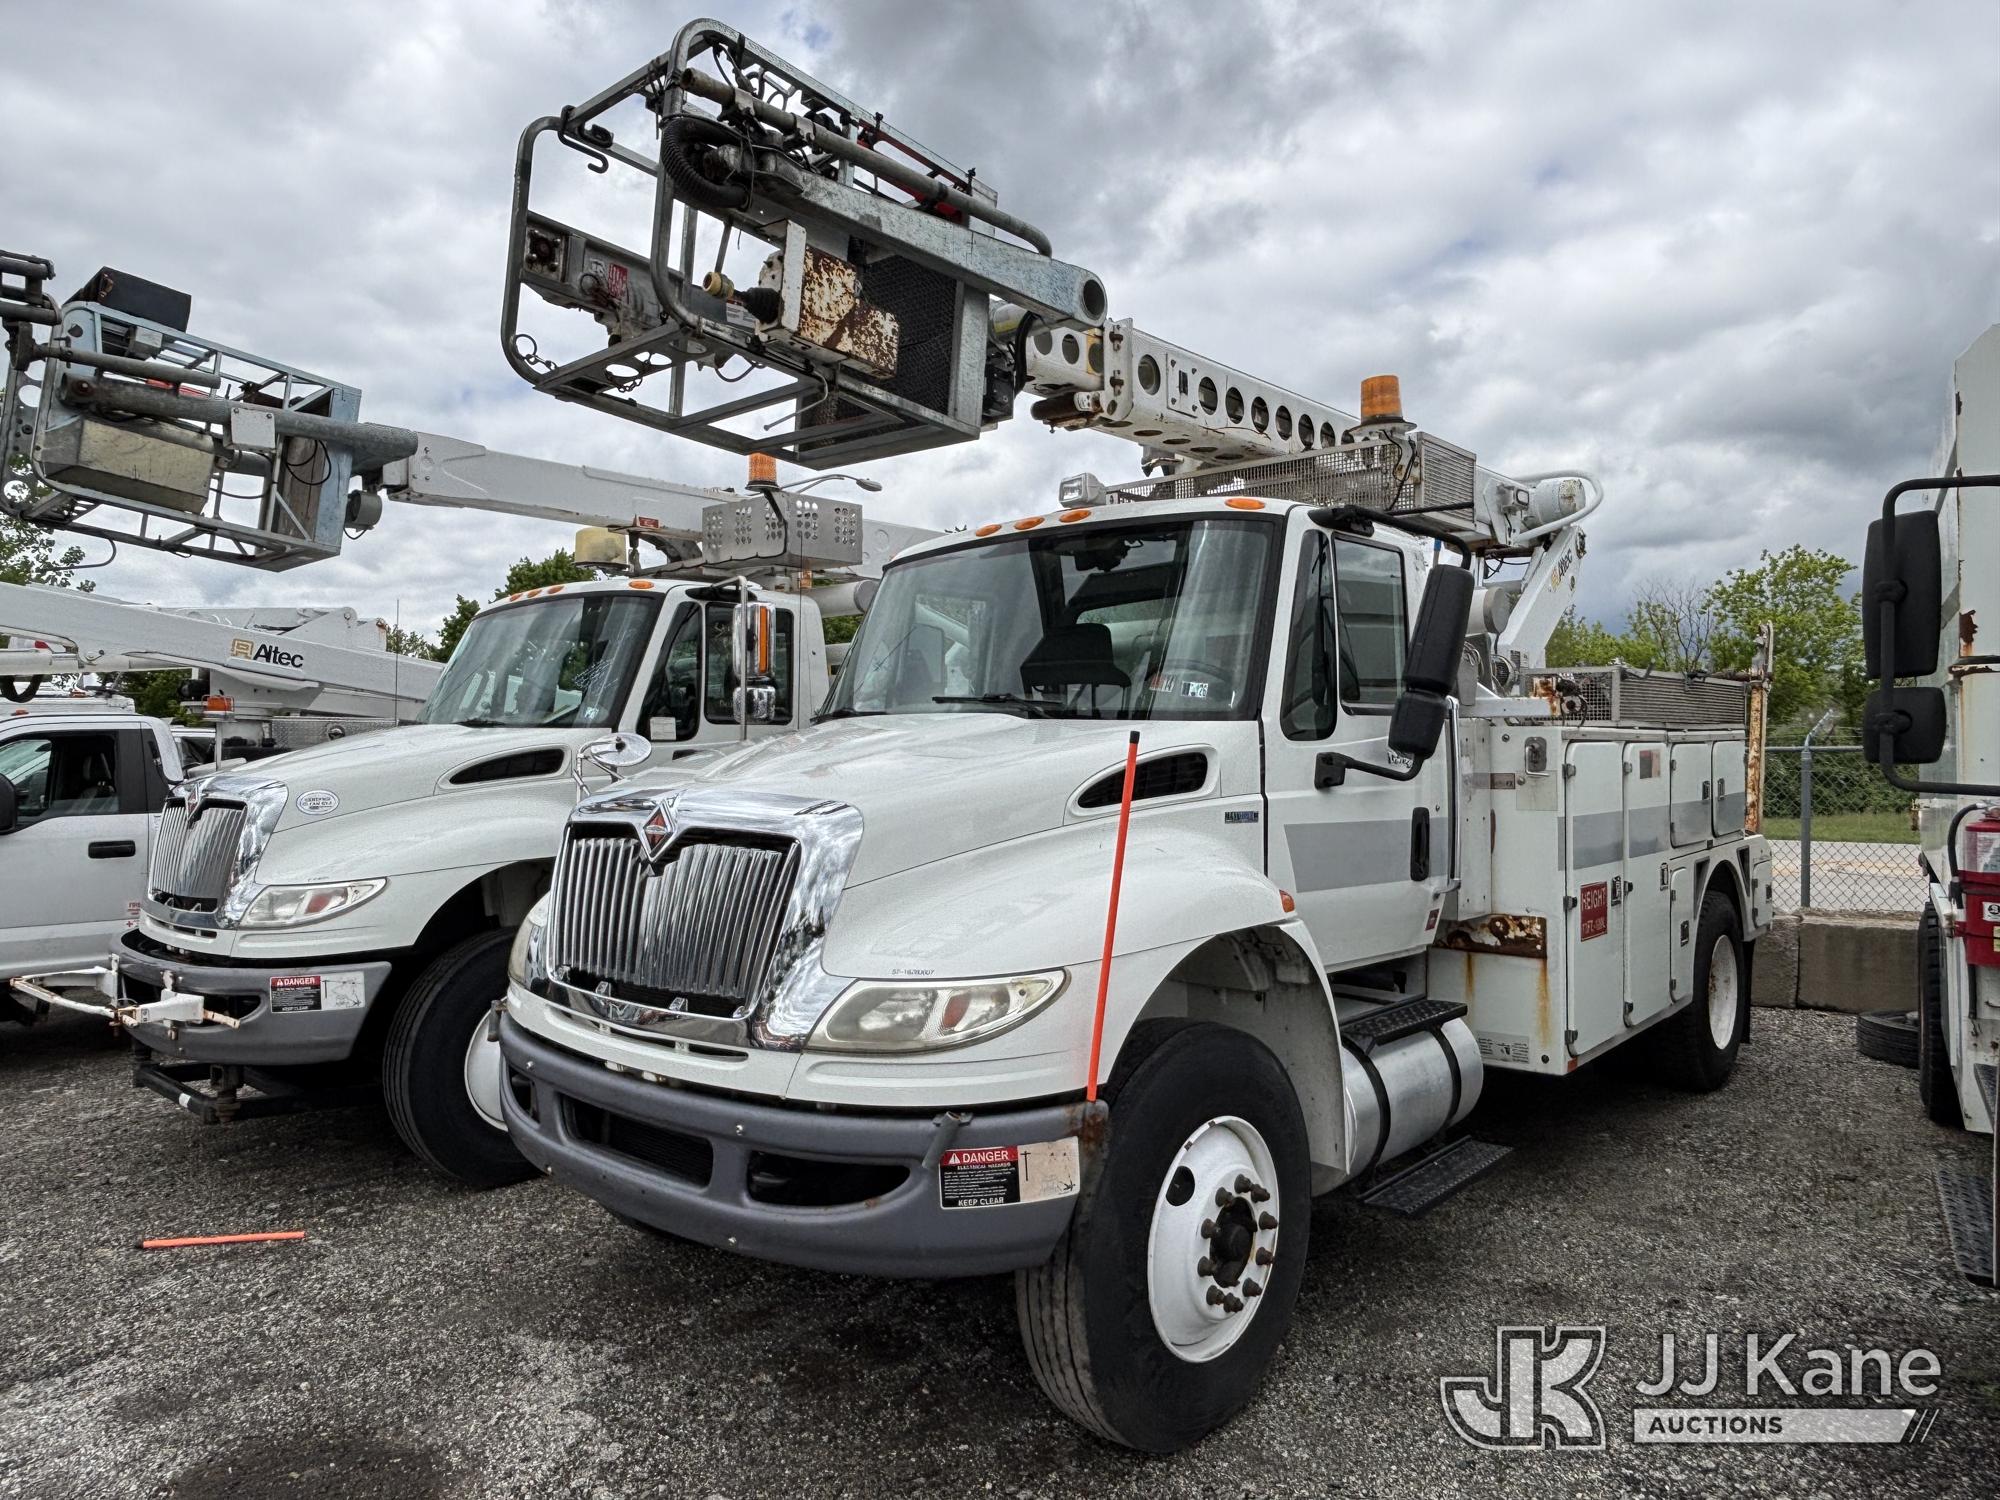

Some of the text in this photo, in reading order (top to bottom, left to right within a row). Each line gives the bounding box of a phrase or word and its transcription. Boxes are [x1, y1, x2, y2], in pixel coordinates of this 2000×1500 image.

[253, 643, 304, 668] Altec
[1581, 887, 1606, 912] HEIGHT
[284, 977, 315, 986] DANGER
[962, 1150, 1009, 1163] DANGER
[958, 1197, 1004, 1207] KEEP CLEAR
